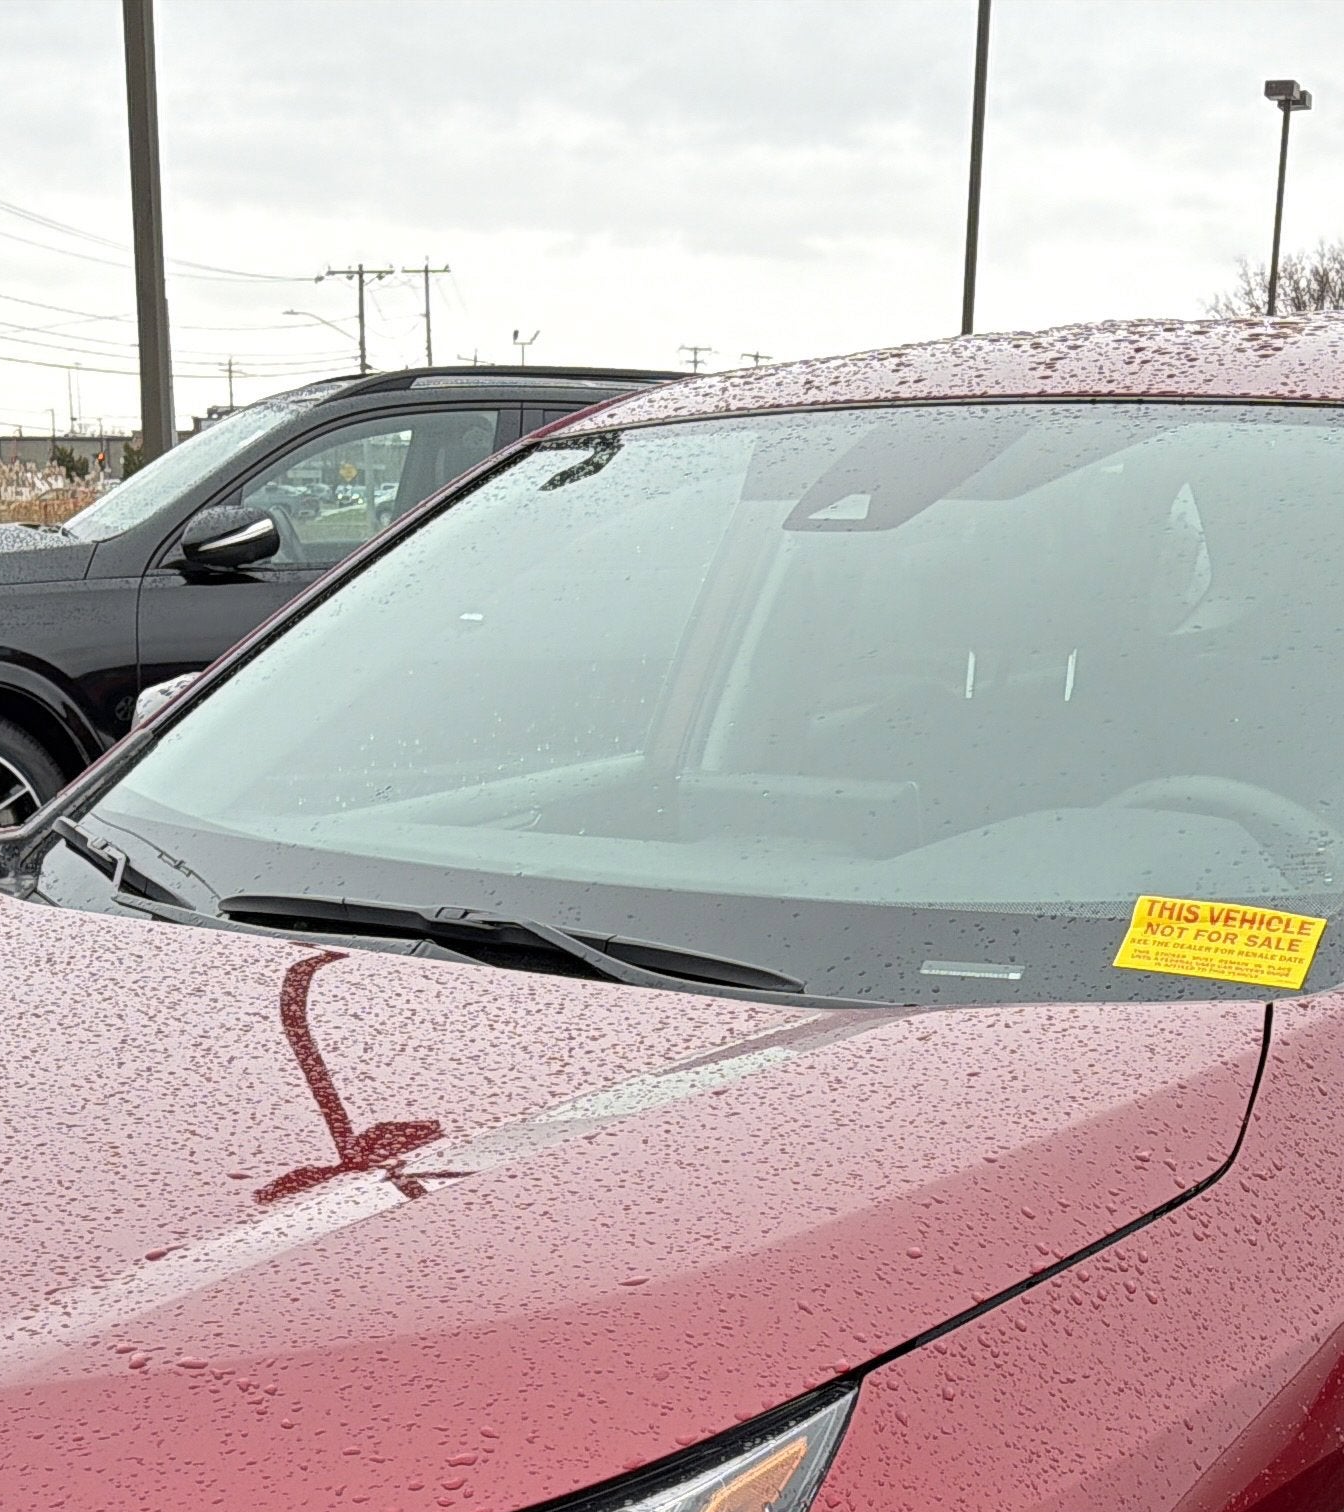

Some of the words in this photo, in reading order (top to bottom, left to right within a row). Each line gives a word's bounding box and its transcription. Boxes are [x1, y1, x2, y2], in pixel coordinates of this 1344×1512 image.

[1146, 899, 1201, 924] THIS
[1209, 906, 1316, 936] VEHICLE
[1143, 921, 1189, 939] NOT
[1193, 929, 1239, 945] FOR
[1244, 934, 1303, 953] SALE
[1152, 939, 1170, 948] THE
[1172, 942, 1212, 953] DEALER
[1213, 946, 1236, 956] FOR
[1278, 954, 1306, 964] DATE
